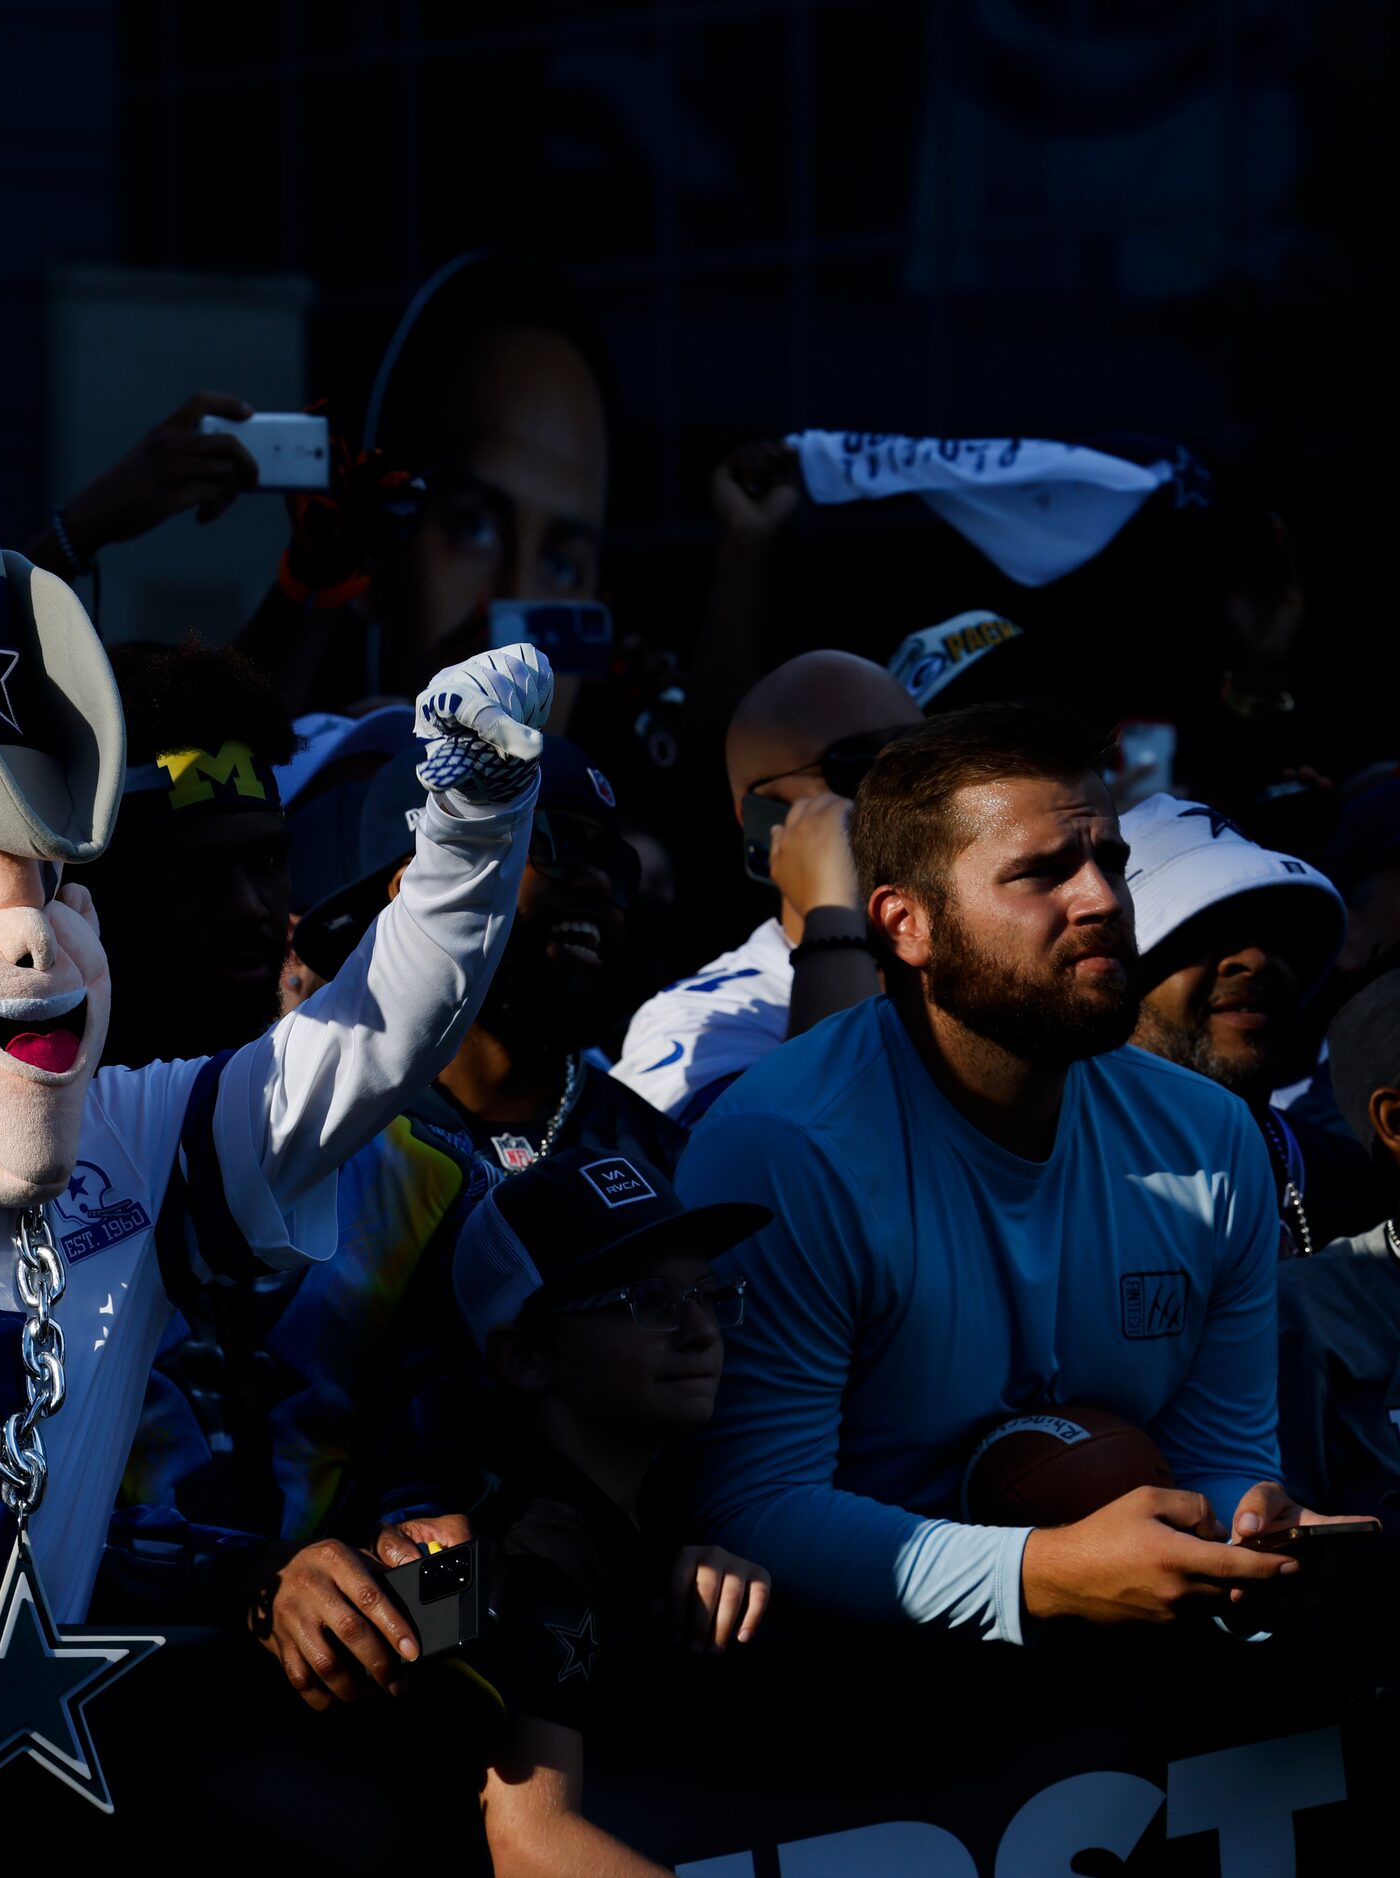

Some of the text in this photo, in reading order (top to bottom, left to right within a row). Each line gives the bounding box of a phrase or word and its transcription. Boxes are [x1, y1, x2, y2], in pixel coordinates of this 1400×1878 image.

[155, 738, 267, 811] M
[606, 1180, 641, 1194] RVCA
[64, 1208, 145, 1258] EST. 1960
[1125, 1280, 1142, 1334] FINTECH
